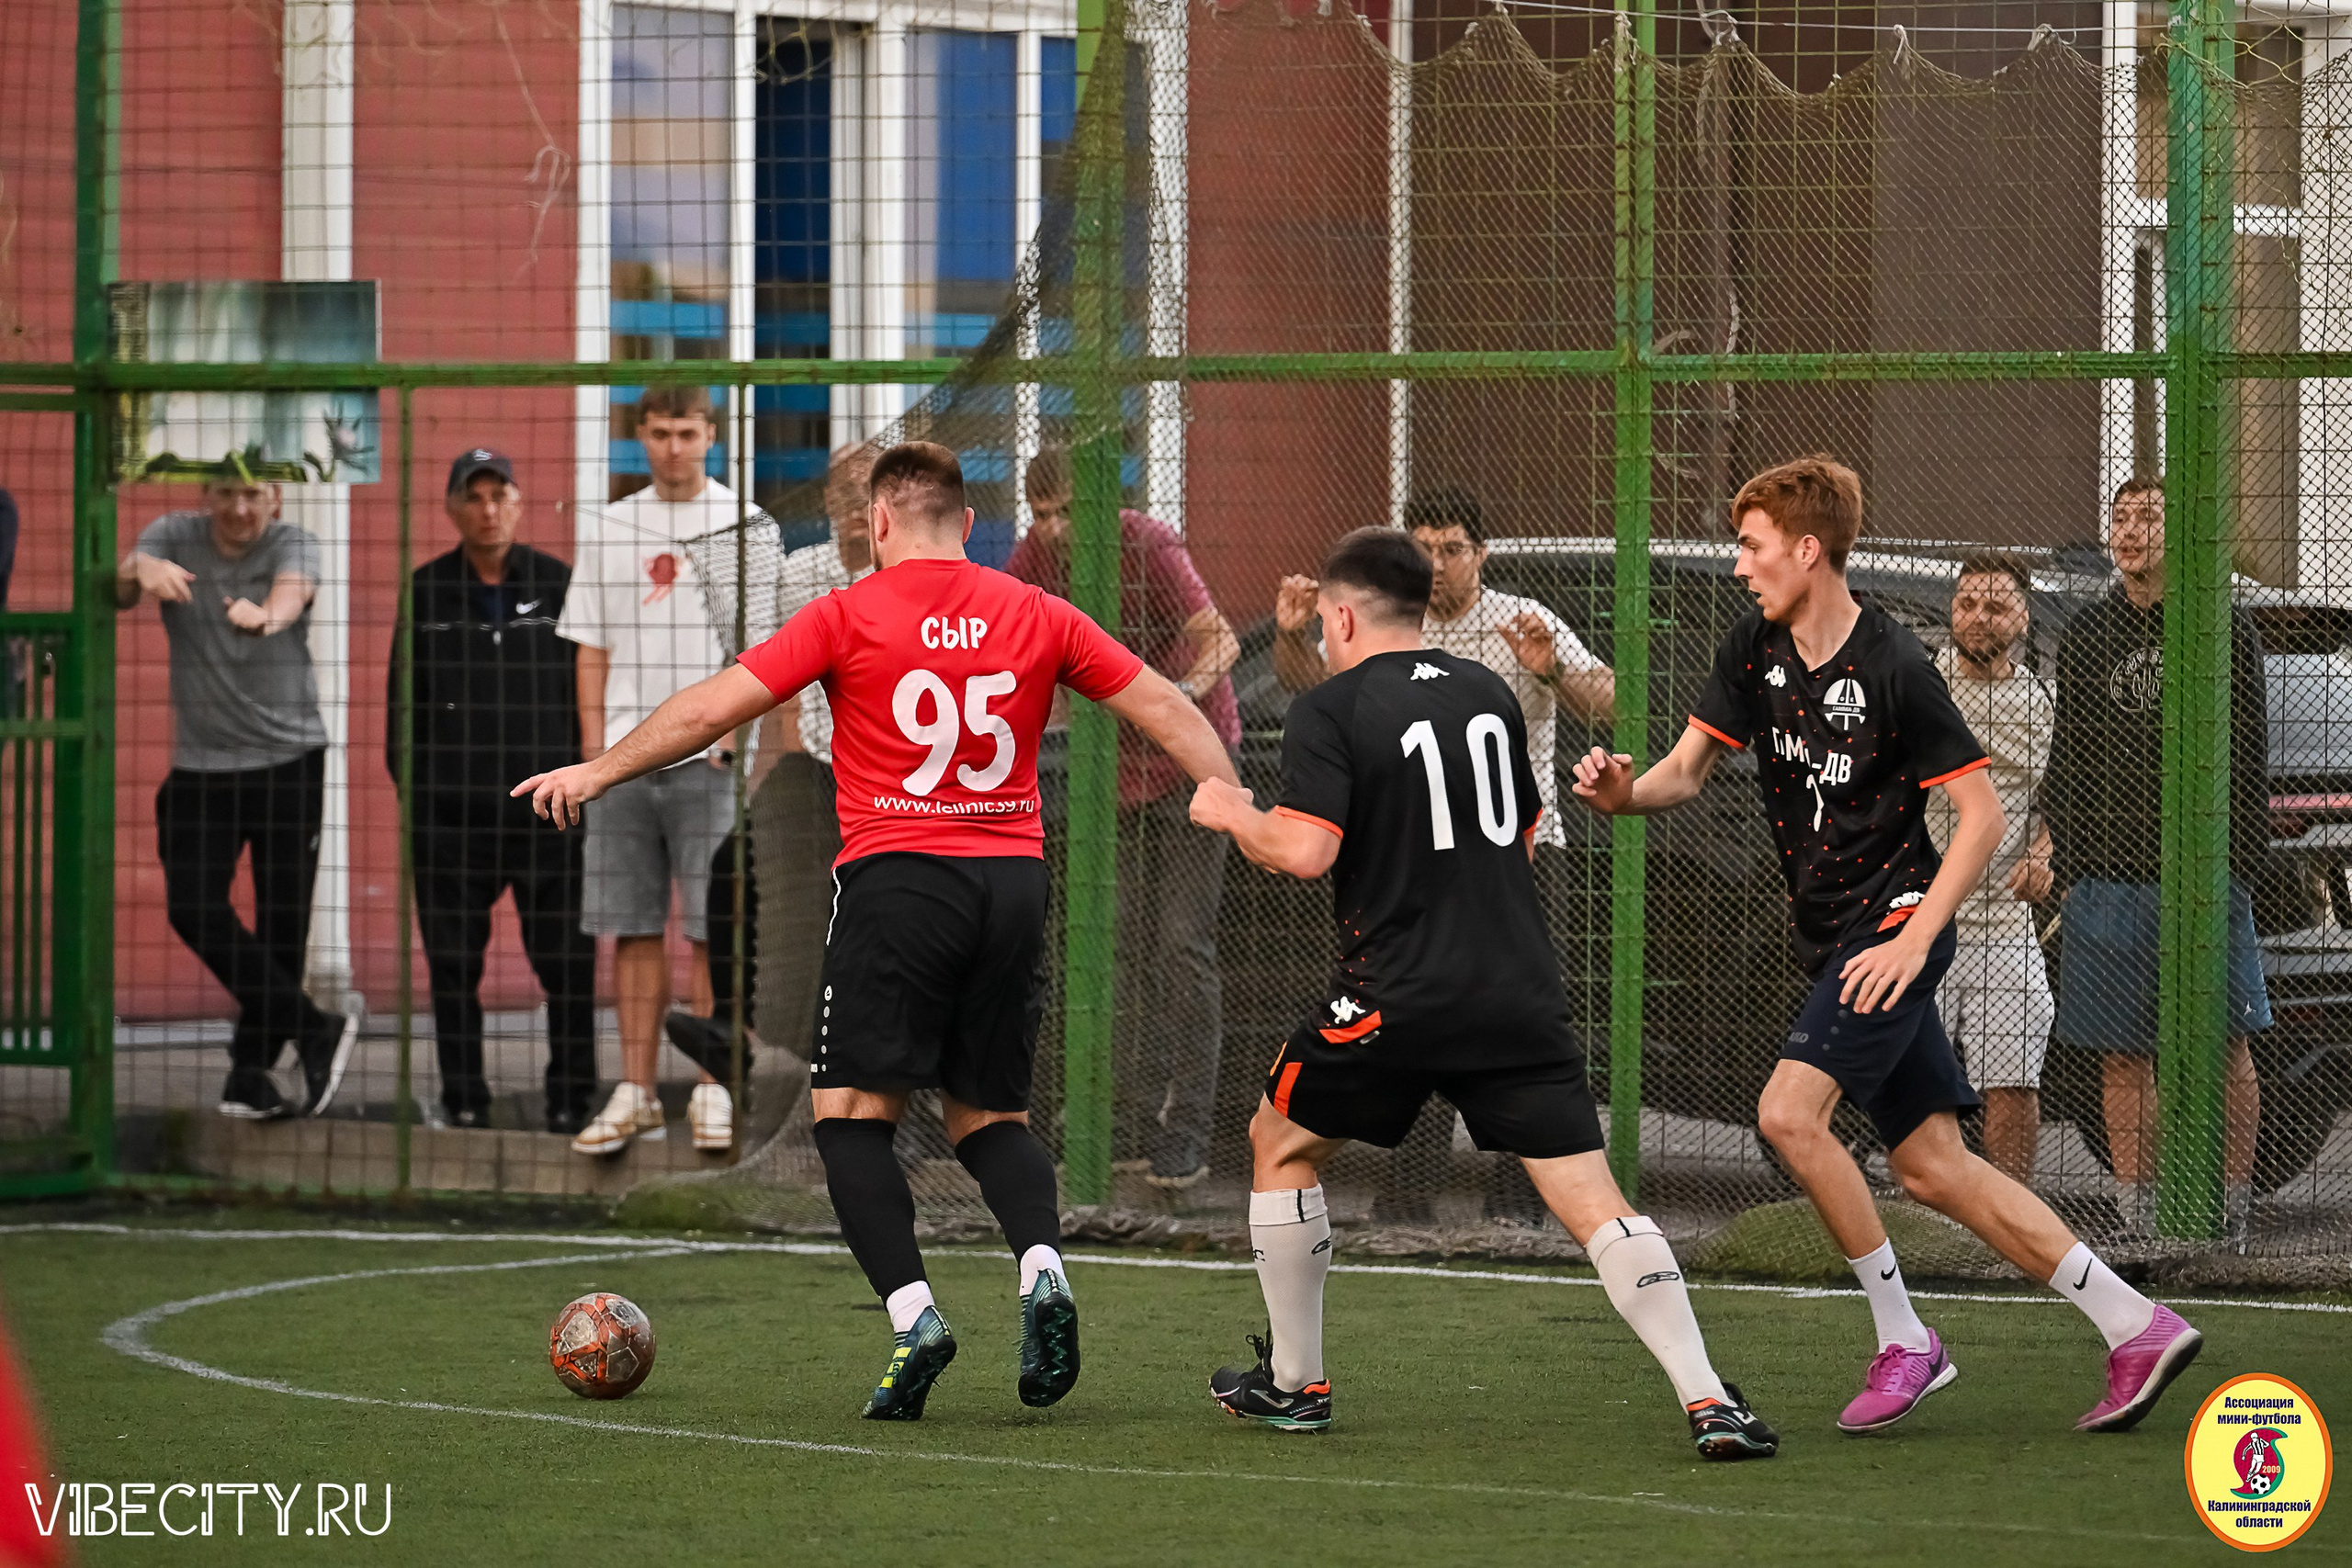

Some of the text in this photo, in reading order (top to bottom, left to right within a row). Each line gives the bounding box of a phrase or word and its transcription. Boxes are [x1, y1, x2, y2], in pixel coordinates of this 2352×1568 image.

[921, 615, 989, 650] СЫР
[891, 669, 1017, 797] 95
[1400, 713, 1518, 851] 10
